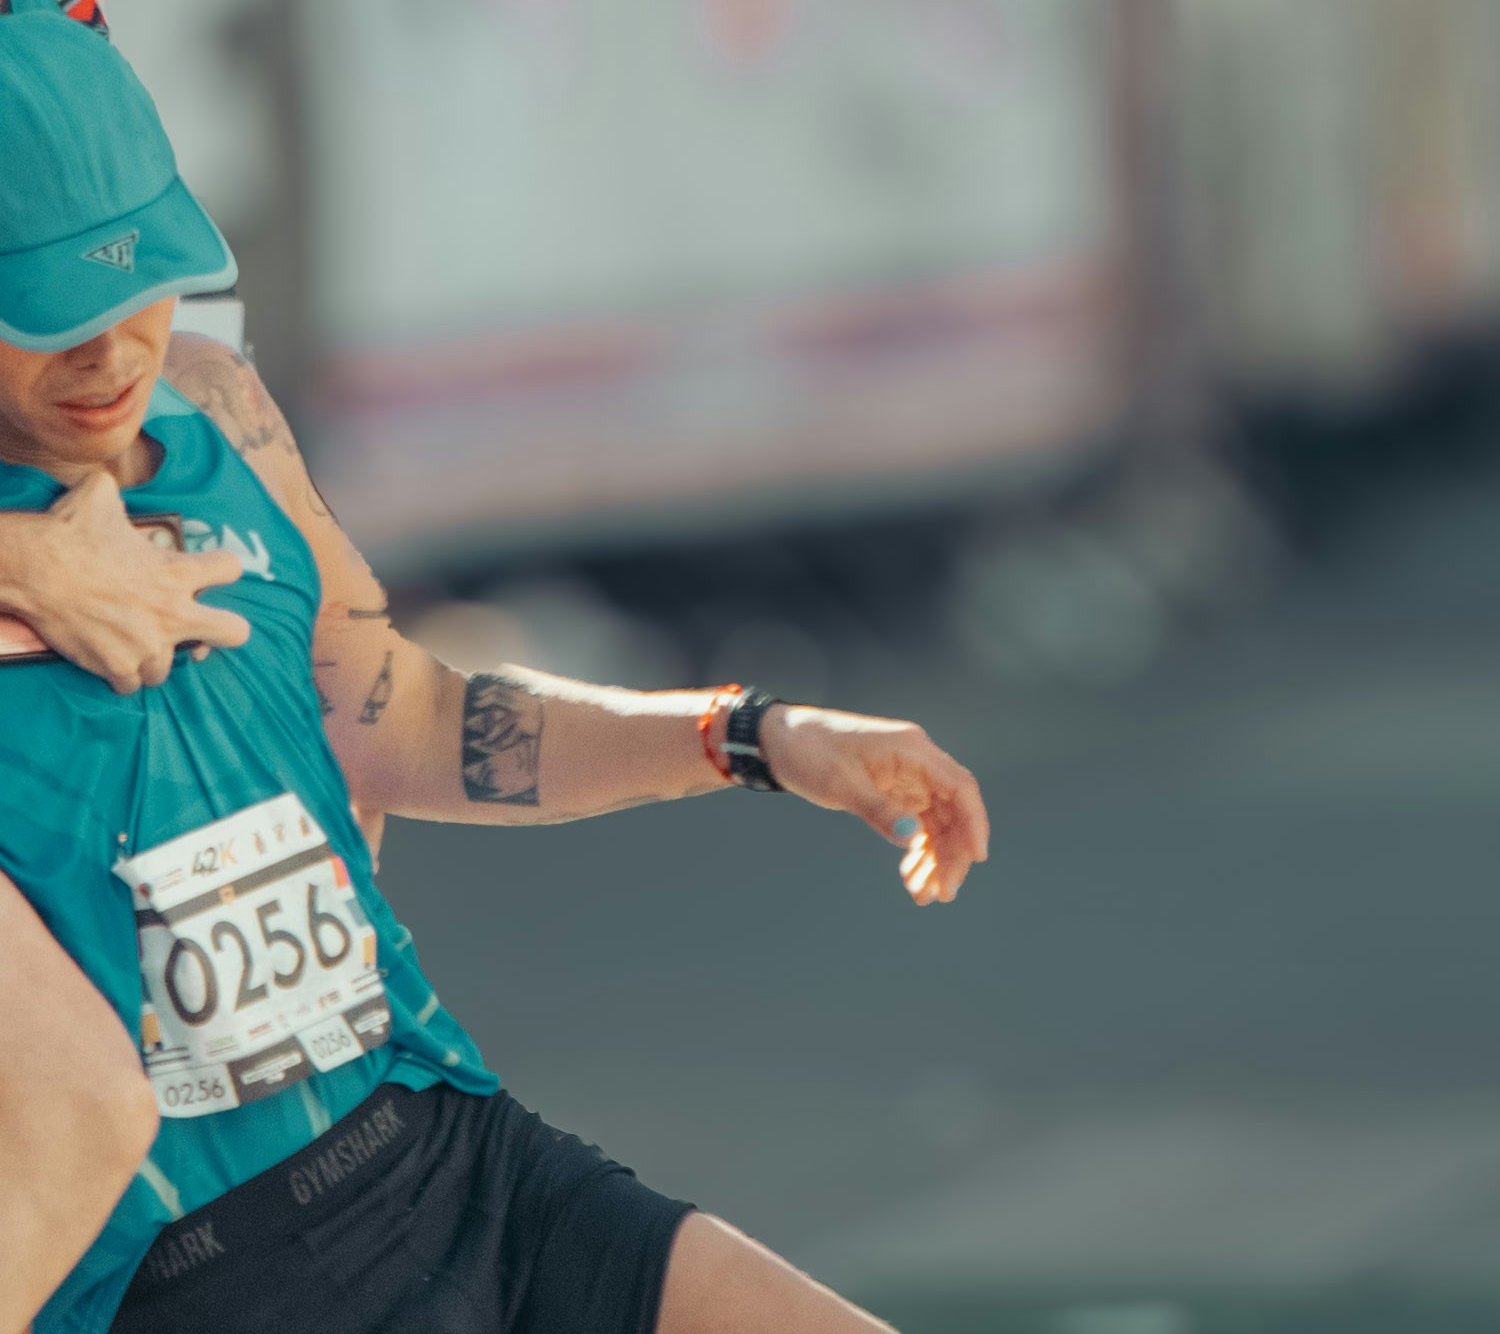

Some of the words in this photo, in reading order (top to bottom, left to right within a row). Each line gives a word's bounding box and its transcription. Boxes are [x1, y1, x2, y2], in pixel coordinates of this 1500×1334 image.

[190, 838, 240, 878] 42K
[164, 883, 352, 1028] 0256
[311, 1027, 352, 1060] 0256
[164, 1078, 226, 1108] 0256
[290, 1099, 405, 1205] GYMSHARK
